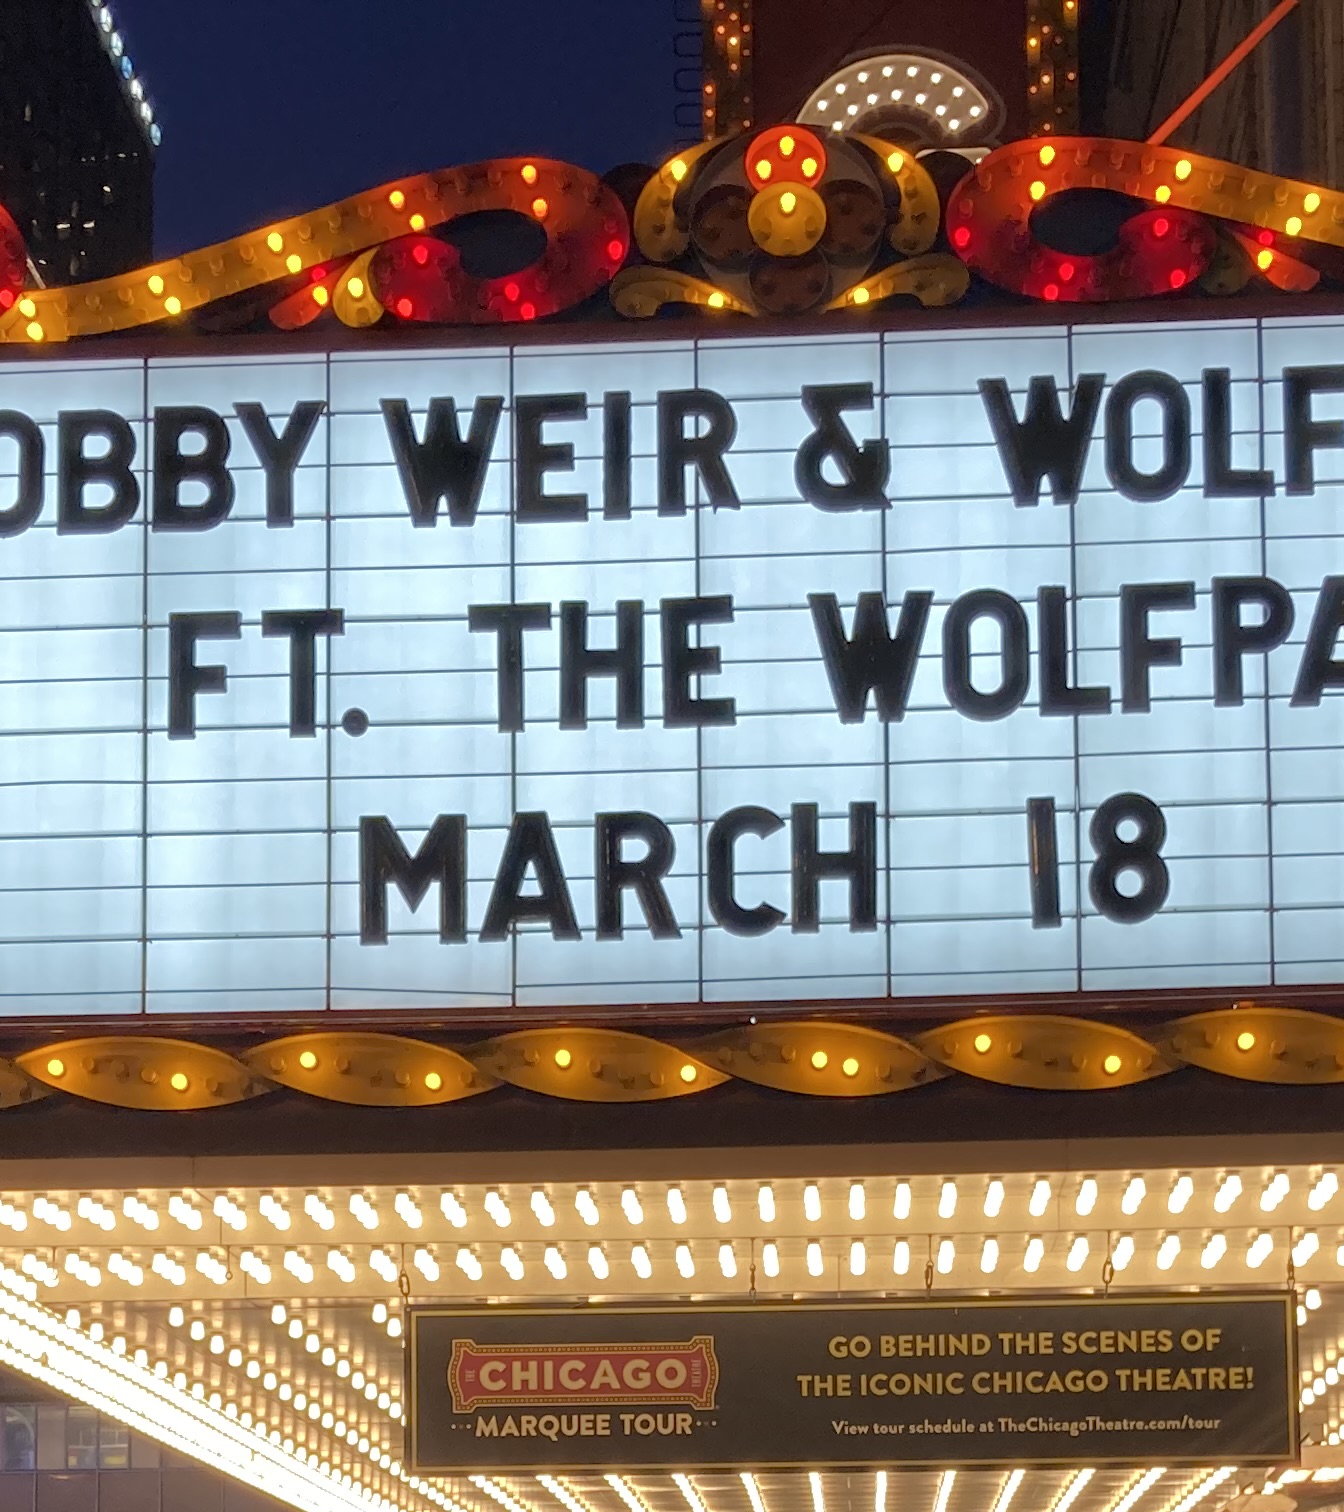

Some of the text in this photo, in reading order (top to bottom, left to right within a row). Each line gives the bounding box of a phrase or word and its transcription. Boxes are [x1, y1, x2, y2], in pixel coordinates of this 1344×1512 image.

[380, 388, 741, 527] WEIR
[796, 382, 892, 512] &
[168, 609, 369, 739] FT.
[468, 595, 738, 733] THE
[358, 792, 1171, 946] MARCH 18
[828, 1328, 1222, 1358] GO BEHIND THE SCENES OF
[464, 1358, 702, 1392] THE CHICAGO THEATRE
[796, 1367, 1254, 1397] THE ICONIC CHICAGO THEATRE!
[474, 1412, 693, 1442] MARQUEE TOUR
[831, 1414, 1222, 1437] View tour schedule at TheChicagoTheatre.com/tour
